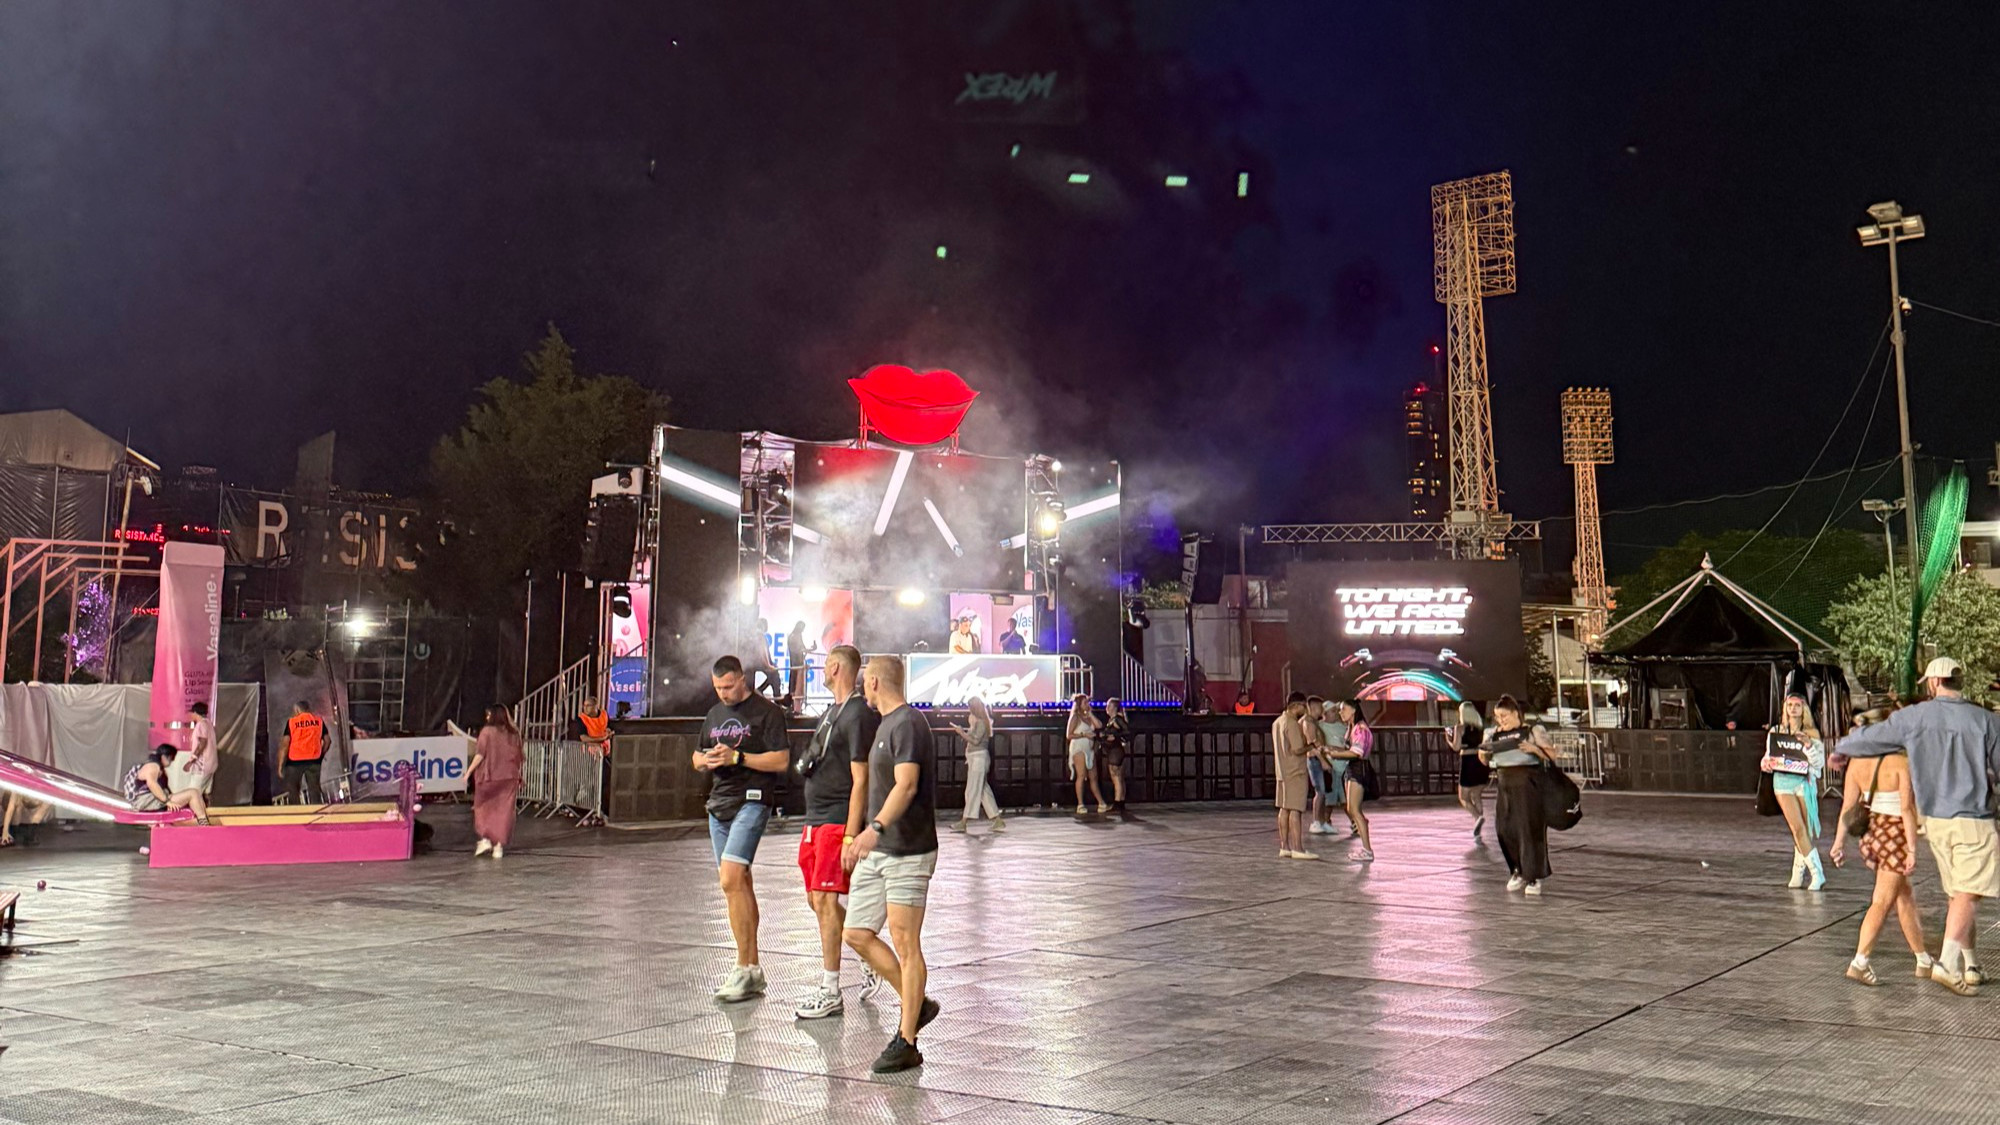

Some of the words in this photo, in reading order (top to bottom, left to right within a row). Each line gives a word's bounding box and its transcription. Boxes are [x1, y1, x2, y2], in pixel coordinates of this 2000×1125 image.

[1335, 588, 1474, 604] TONIGHT.
[1344, 604, 1398, 618] WE
[1401, 604, 1468, 618] ARE
[204, 580, 219, 661] Vaseline
[1345, 620, 1464, 634] UNITED.
[932, 666, 1039, 705] WREX
[709, 725, 730, 738] Hard
[730, 724, 751, 738] Rock
